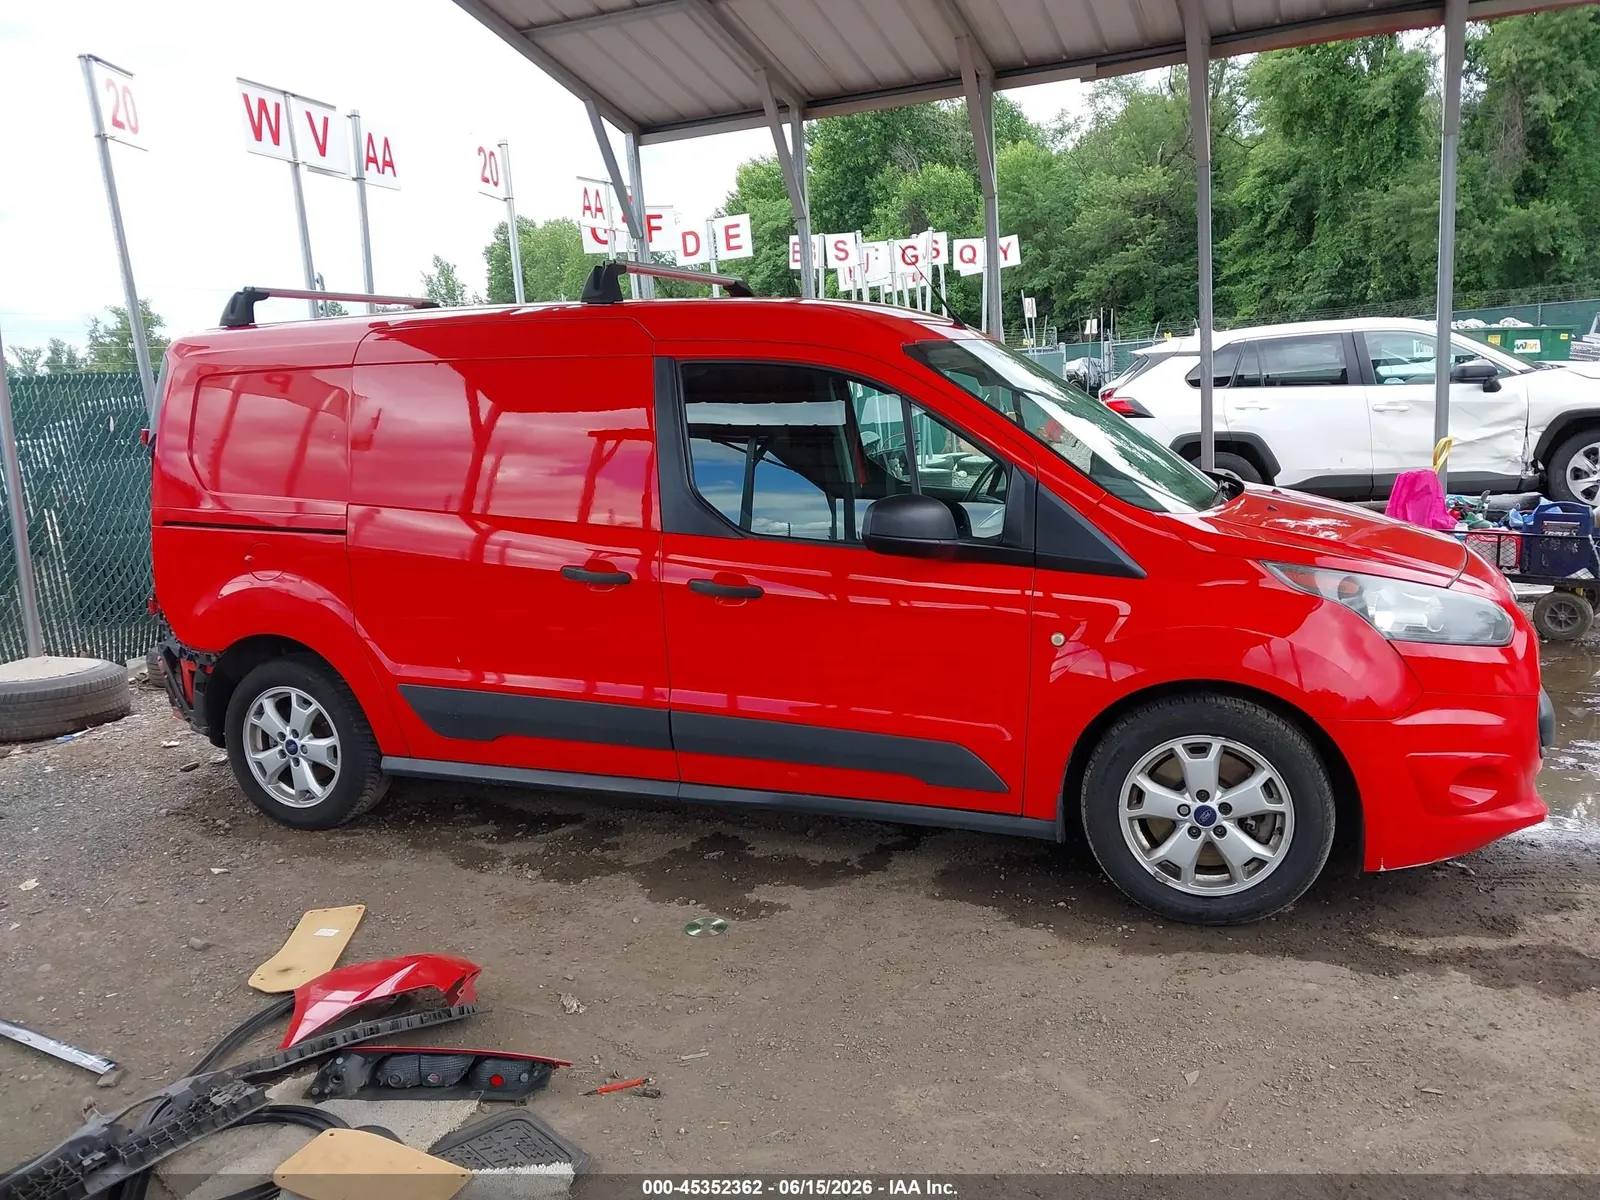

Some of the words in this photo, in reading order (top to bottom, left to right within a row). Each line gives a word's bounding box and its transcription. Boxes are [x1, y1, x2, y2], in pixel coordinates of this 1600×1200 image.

[106, 79, 140, 135] 20
[242, 93, 281, 147] W
[305, 110, 329, 158] V
[365, 132, 397, 177] AA
[478, 146, 499, 188] 20
[582, 187, 605, 220] AA
[645, 214, 663, 243] F
[724, 223, 743, 251] E
[681, 230, 701, 257] D
[833, 239, 849, 262] S
[901, 245, 919, 266] G
[959, 244, 977, 265] Q
[999, 242, 1012, 261] Y
